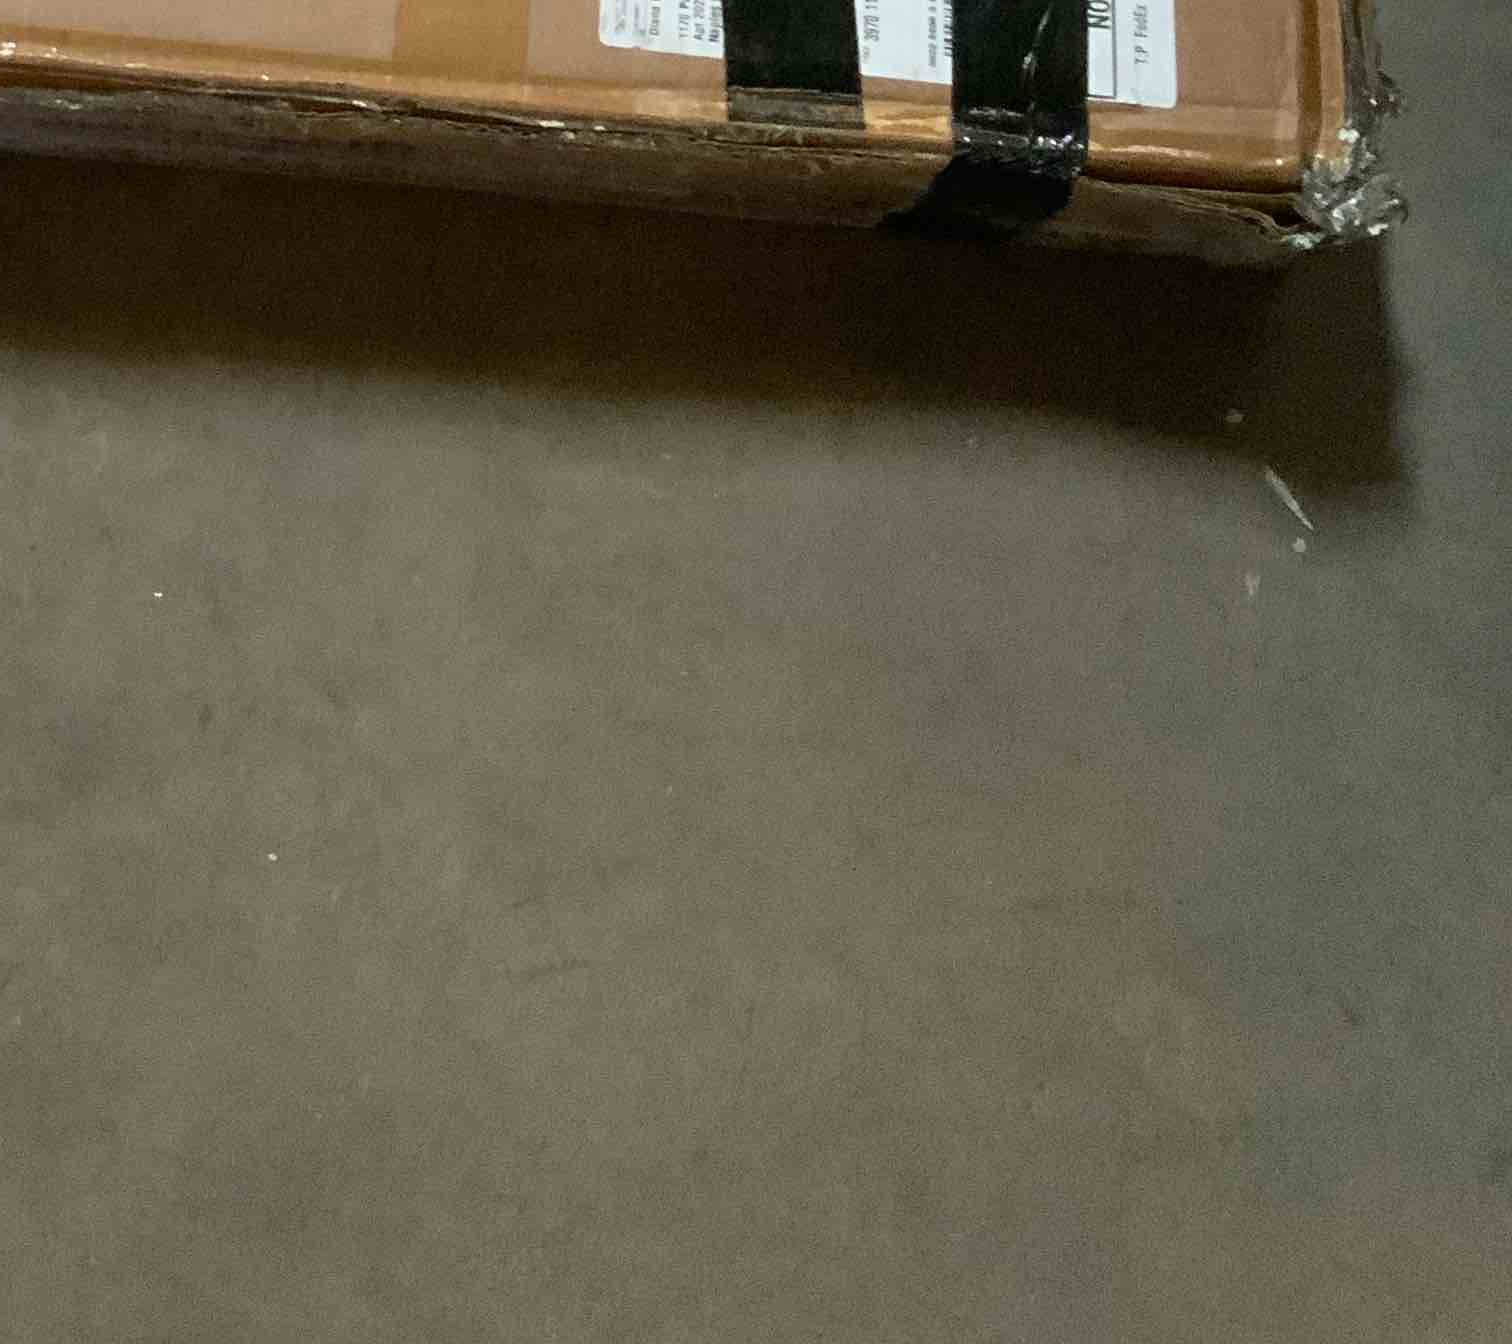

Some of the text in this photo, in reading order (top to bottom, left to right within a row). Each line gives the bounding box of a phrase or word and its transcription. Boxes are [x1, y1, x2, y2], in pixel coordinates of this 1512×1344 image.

[650, 6, 661, 36] Diana
[1087, 0, 1111, 29] NO
[1134, 4, 1148, 38] FedEx
[693, 23, 706, 41] Apt
